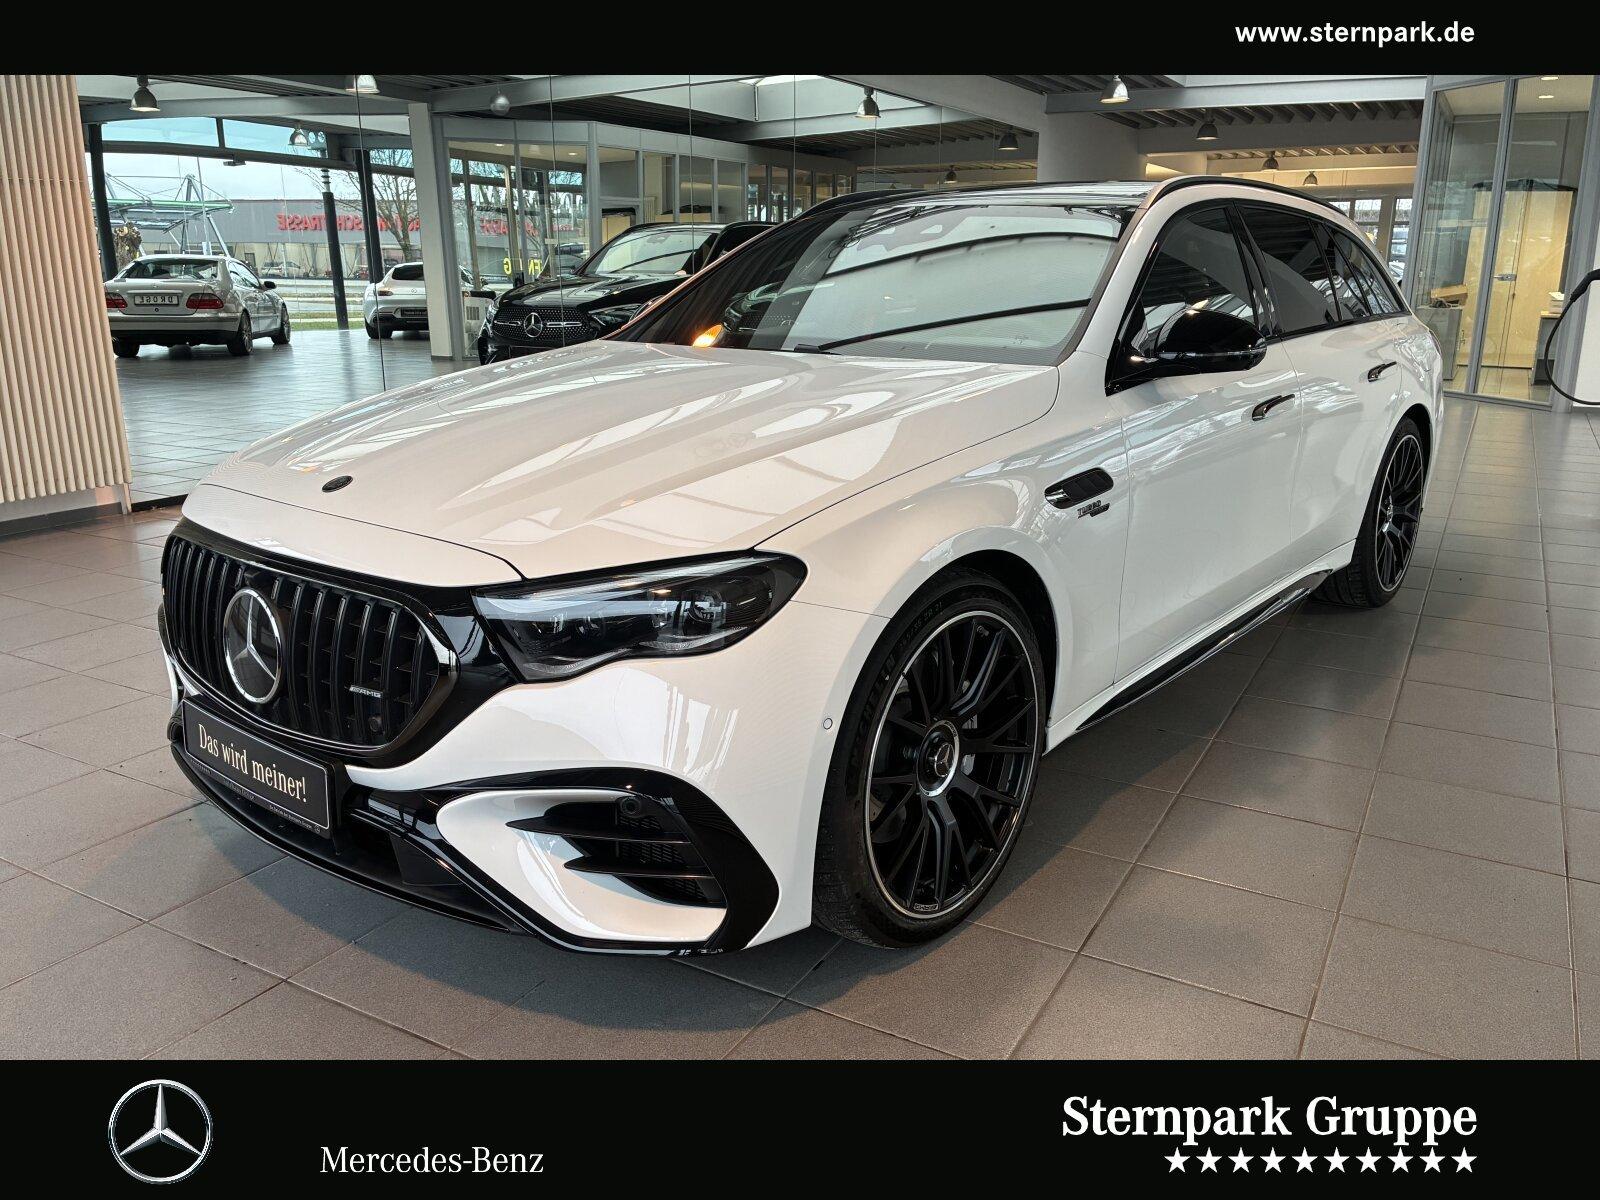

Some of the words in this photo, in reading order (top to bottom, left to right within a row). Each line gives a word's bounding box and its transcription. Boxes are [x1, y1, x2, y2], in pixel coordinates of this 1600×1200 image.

[198, 723, 219, 758] Das
[221, 743, 249, 775] wird
[251, 760, 307, 803] meiner!
